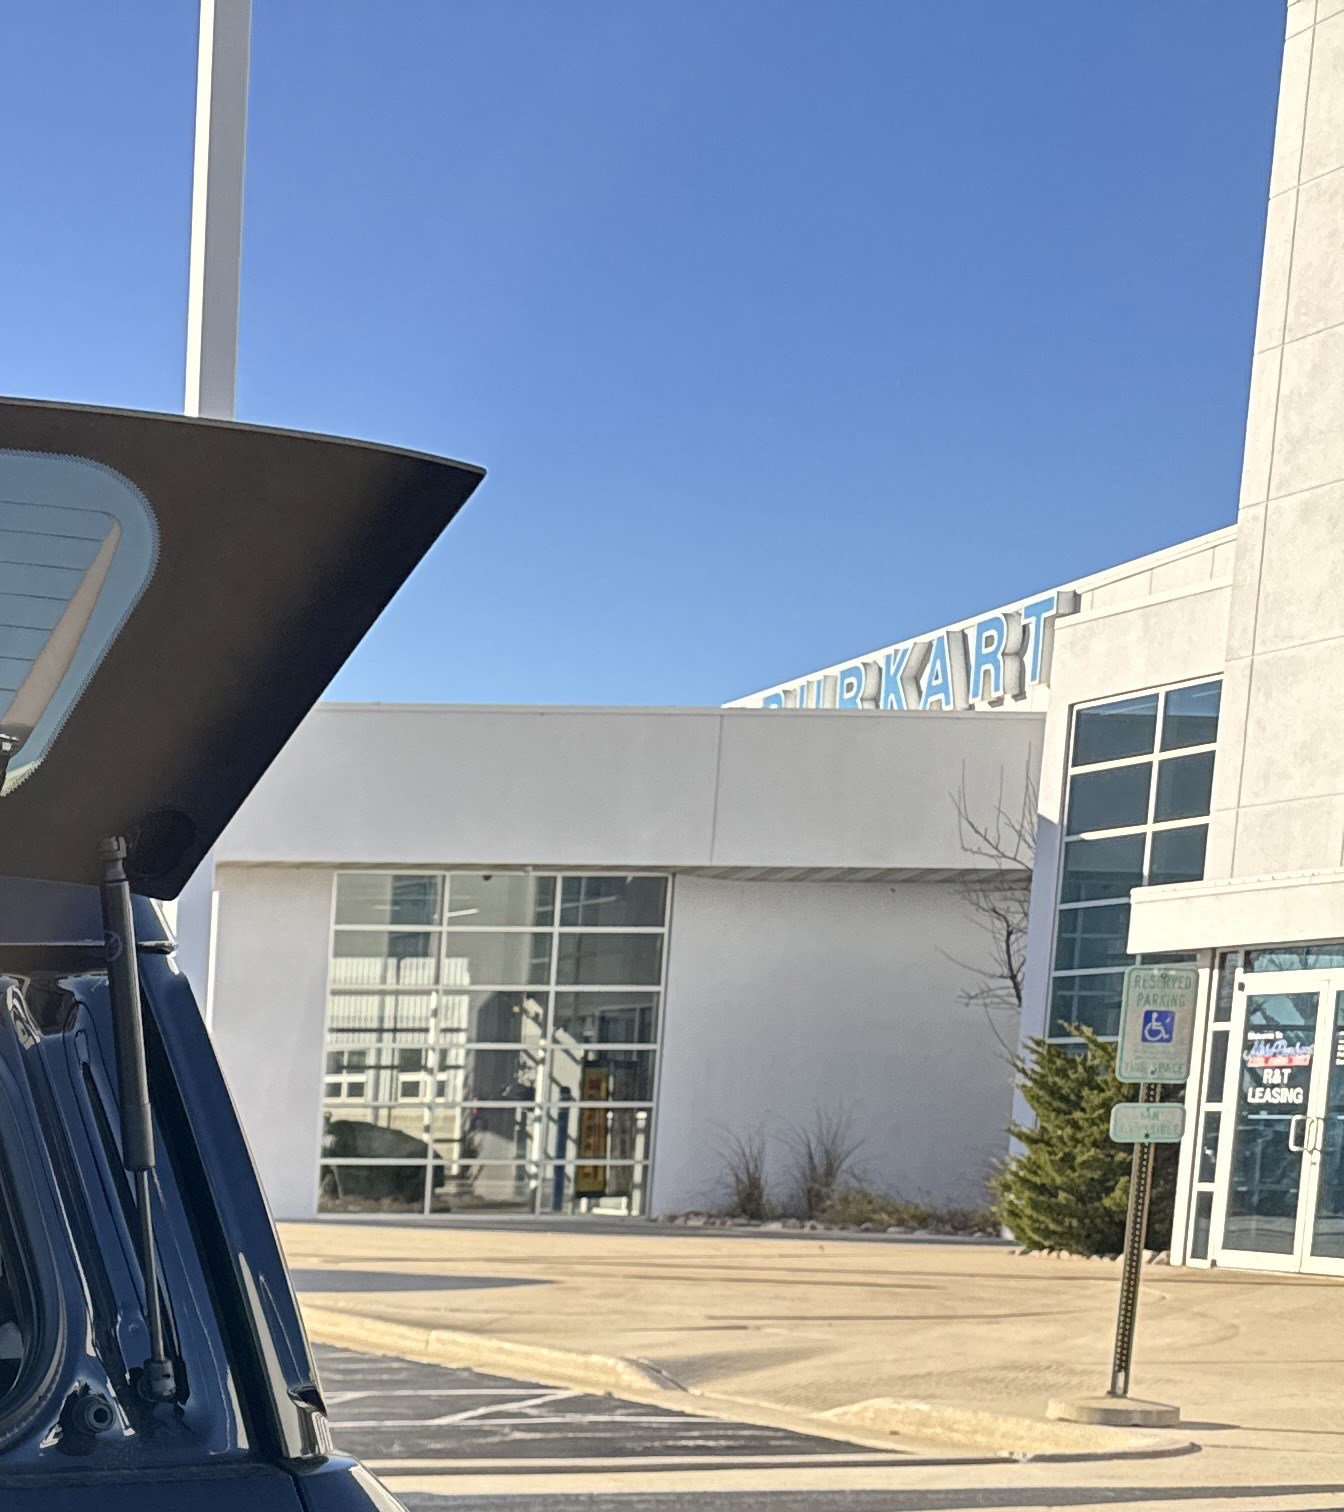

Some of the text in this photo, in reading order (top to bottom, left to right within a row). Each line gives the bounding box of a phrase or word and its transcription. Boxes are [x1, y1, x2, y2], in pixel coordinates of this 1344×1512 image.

[761, 595, 1057, 711] RKART
[1136, 993, 1186, 1008] PARKING
[1263, 1068, 1291, 1084] R&T
[1247, 1087, 1303, 1104] LEASING
